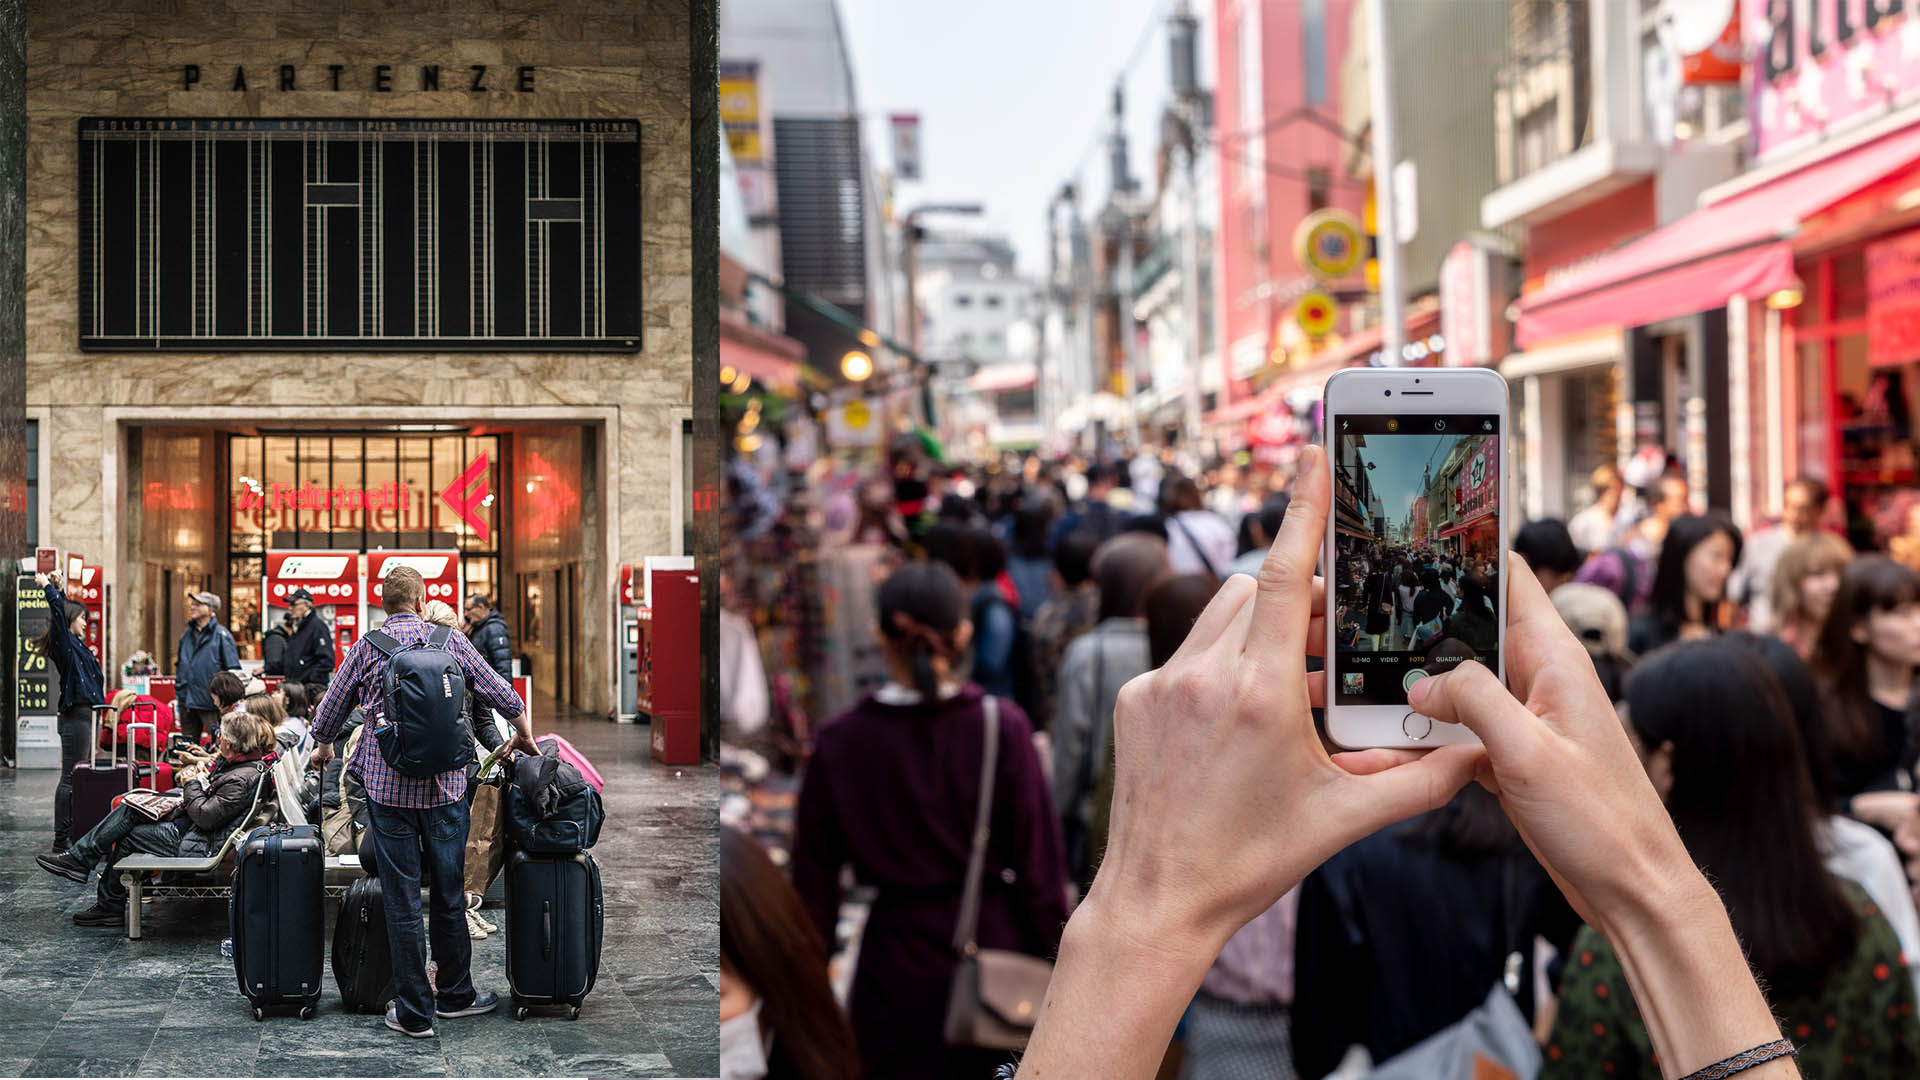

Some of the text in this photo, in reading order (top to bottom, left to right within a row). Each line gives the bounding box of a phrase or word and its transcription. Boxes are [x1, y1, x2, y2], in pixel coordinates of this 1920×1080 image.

[183, 64, 536, 92] PARTENZE
[271, 481, 411, 511] Feltrinelli
[1435, 656, 1464, 664] QUADRAT
[442, 673, 453, 699] THULE
